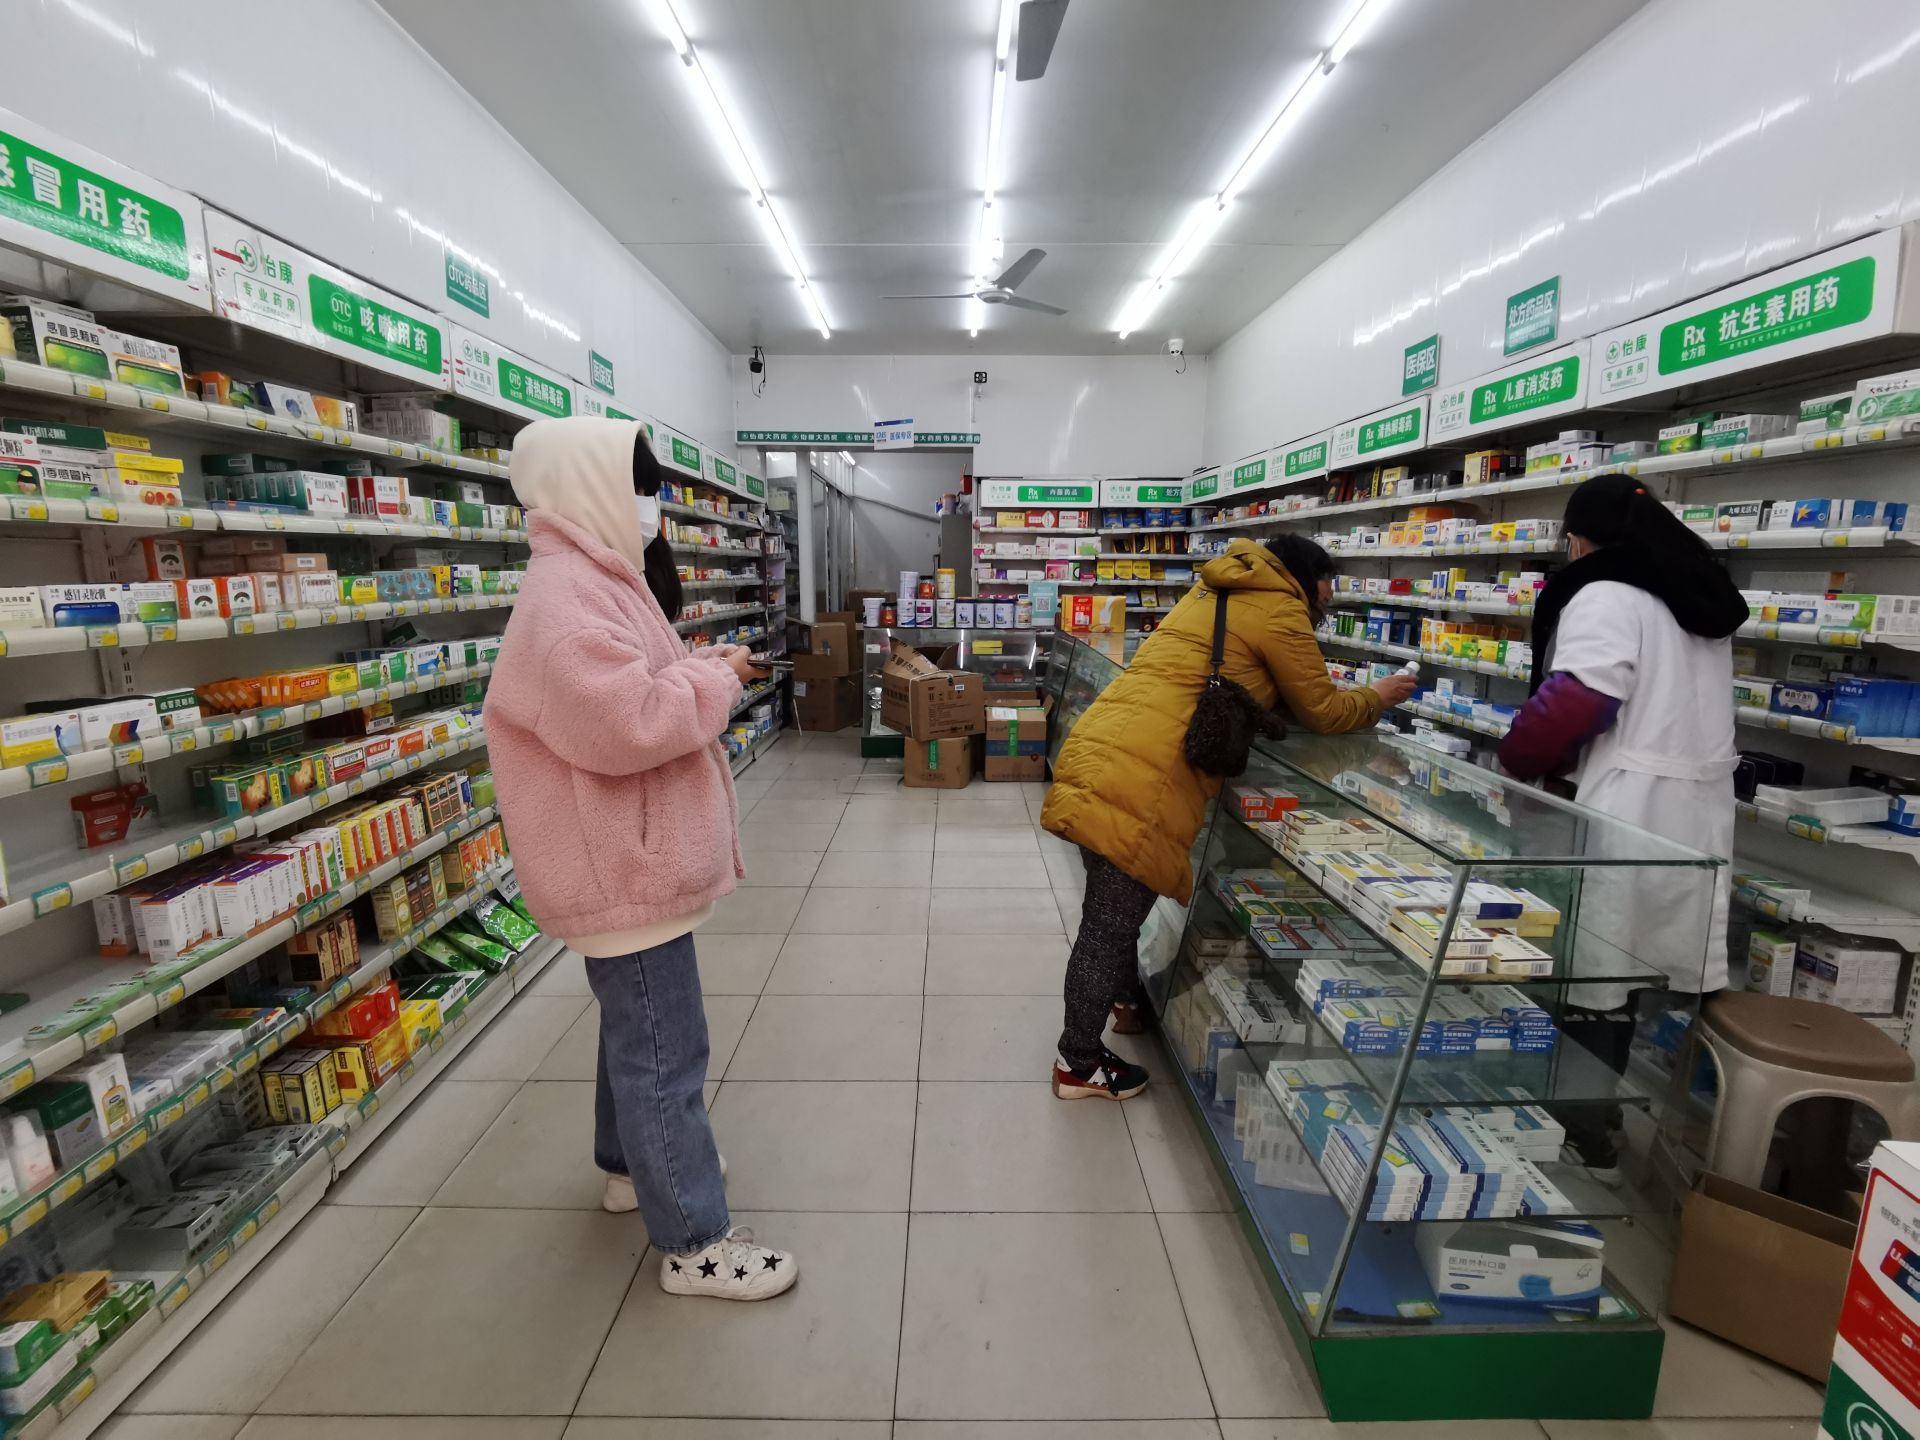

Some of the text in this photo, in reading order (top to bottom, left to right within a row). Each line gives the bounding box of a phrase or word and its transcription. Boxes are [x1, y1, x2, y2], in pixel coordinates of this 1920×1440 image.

[263, 254, 294, 286] 怡康
[243, 281, 296, 313] 专业药房
[331, 297, 352, 317] OTC
[1508, 289, 1556, 329] 处方药品区
[1718, 276, 1841, 342] 抗生素用药
[359, 305, 428, 355] 咳嗽用药
[1683, 325, 1706, 348] Rx
[1622, 333, 1648, 357] 怡康
[1680, 345, 1706, 362] 处方药
[1406, 343, 1437, 379] 医保区
[509, 372, 522, 386] OTC
[1605, 362, 1645, 382] 专业药房
[1503, 366, 1564, 404] 儿童消炎药
[1484, 389, 1497, 405] Rx
[750, 433, 787, 441] 怡康大药房
[800, 433, 838, 442] 怡康大药房
[1028, 488, 1038, 496] Rx
[1448, 1256, 1507, 1270] 医用外科口罩
